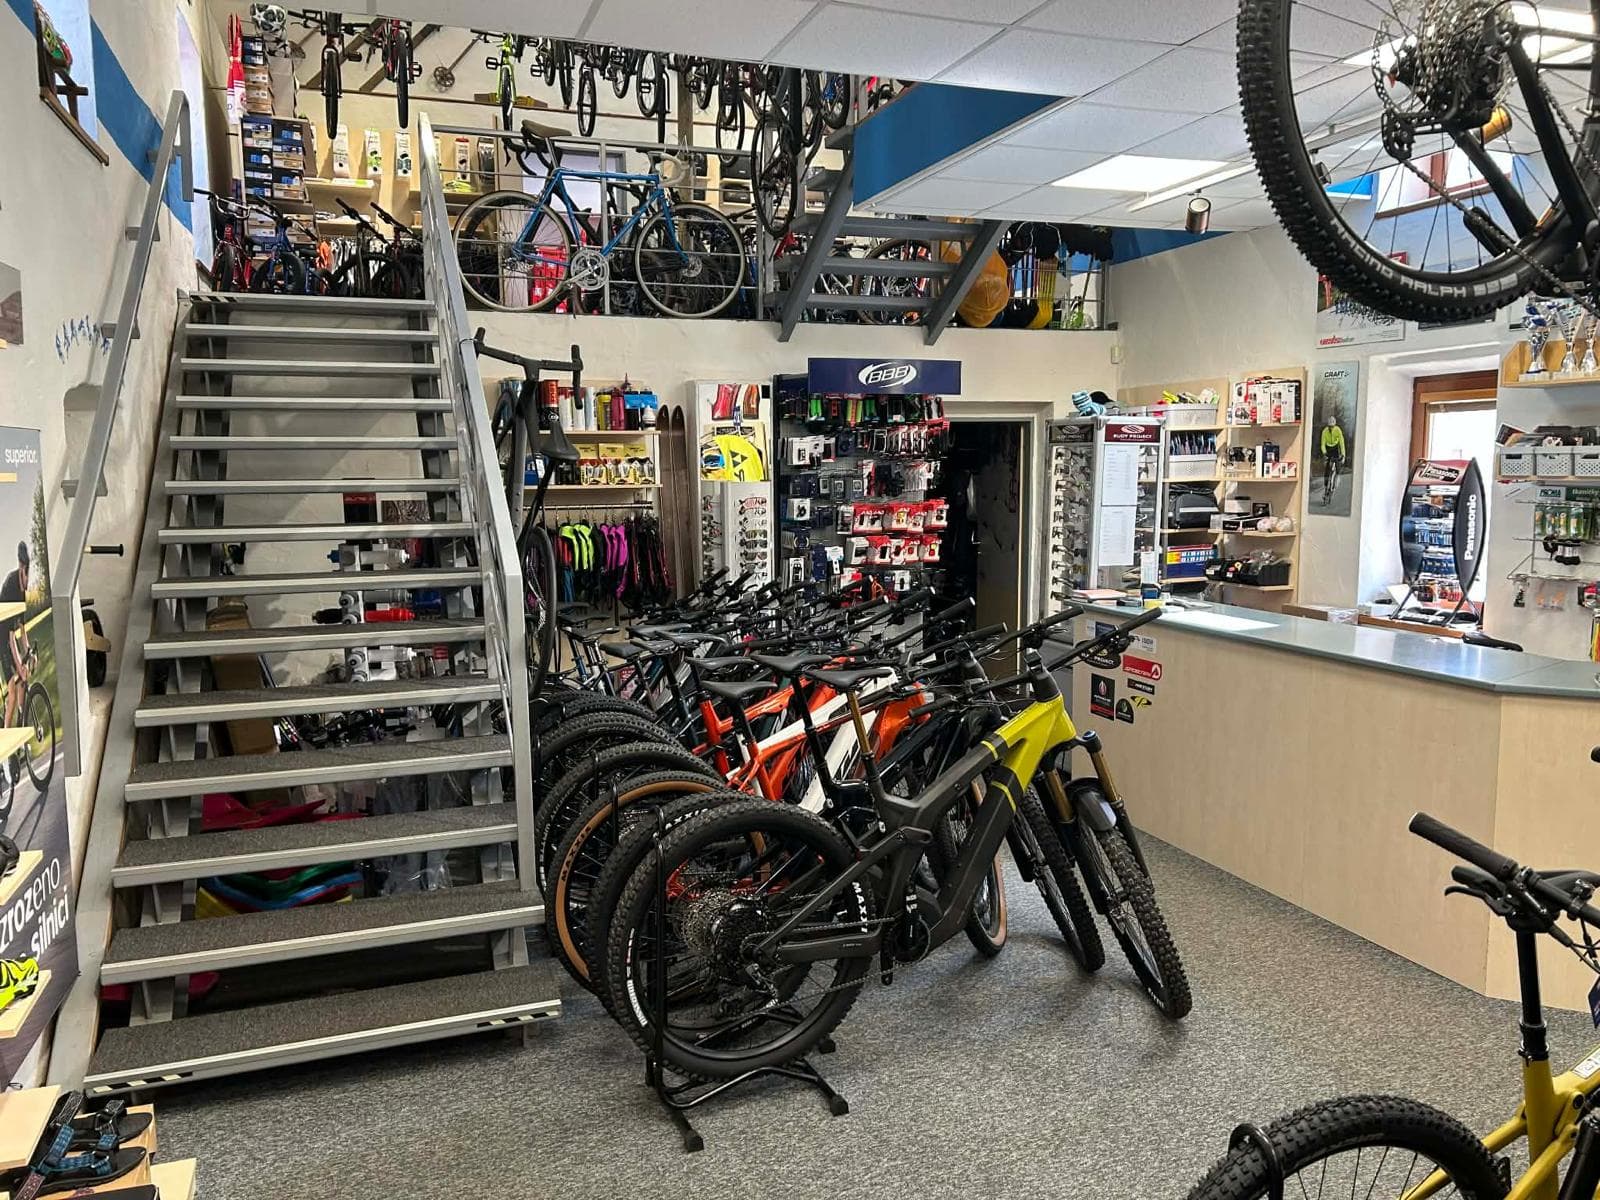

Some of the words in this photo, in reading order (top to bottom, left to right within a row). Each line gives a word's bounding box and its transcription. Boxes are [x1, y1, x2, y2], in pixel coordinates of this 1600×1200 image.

[1330, 217, 1394, 278] RACING
[1400, 276, 1467, 298] RALPH
[866, 364, 911, 385] BBB
[1324, 370, 1345, 378] CRAFT
[1464, 494, 1478, 561] Panasonic
[561, 825, 592, 882] MAXXIS
[0, 858, 60, 953] zrozeno
[31, 885, 69, 962] silnici
